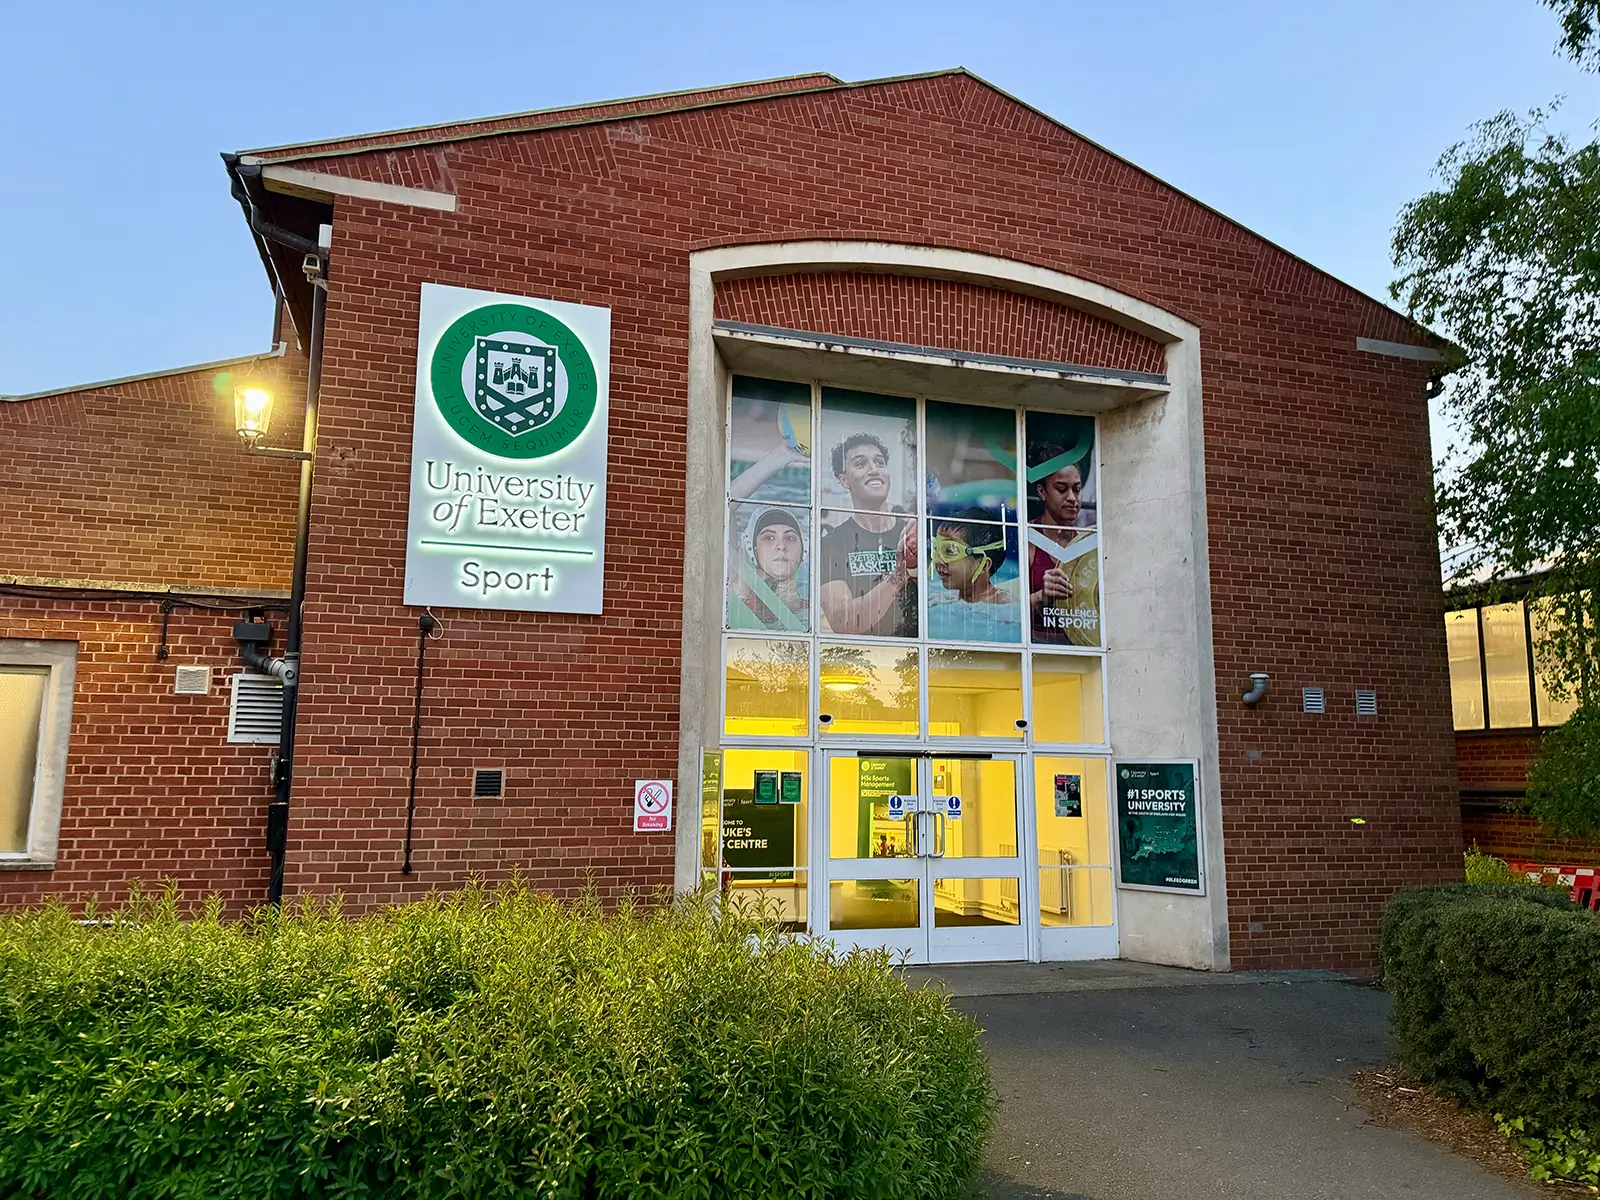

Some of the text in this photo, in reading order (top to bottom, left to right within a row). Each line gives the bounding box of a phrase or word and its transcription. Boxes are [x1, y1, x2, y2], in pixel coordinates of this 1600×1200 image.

[440, 311, 589, 391] UNIVERSITY OF EXETER
[444, 395, 584, 451] LUCEM SEQUIMUR
[426, 460, 595, 510] University
[433, 494, 586, 533] of Exeter
[849, 553, 876, 562] EXETER
[461, 561, 554, 595] Sport
[1043, 607, 1097, 618] EXCELLENCE
[1043, 616, 1098, 630] IN SPORT
[872, 774, 890, 782] Sports
[1127, 788, 1186, 801] #1 SPORTS
[1127, 800, 1186, 811] UNIVERSITY
[722, 827, 752, 838] UKE'S
[726, 839, 768, 849] CENTRE
